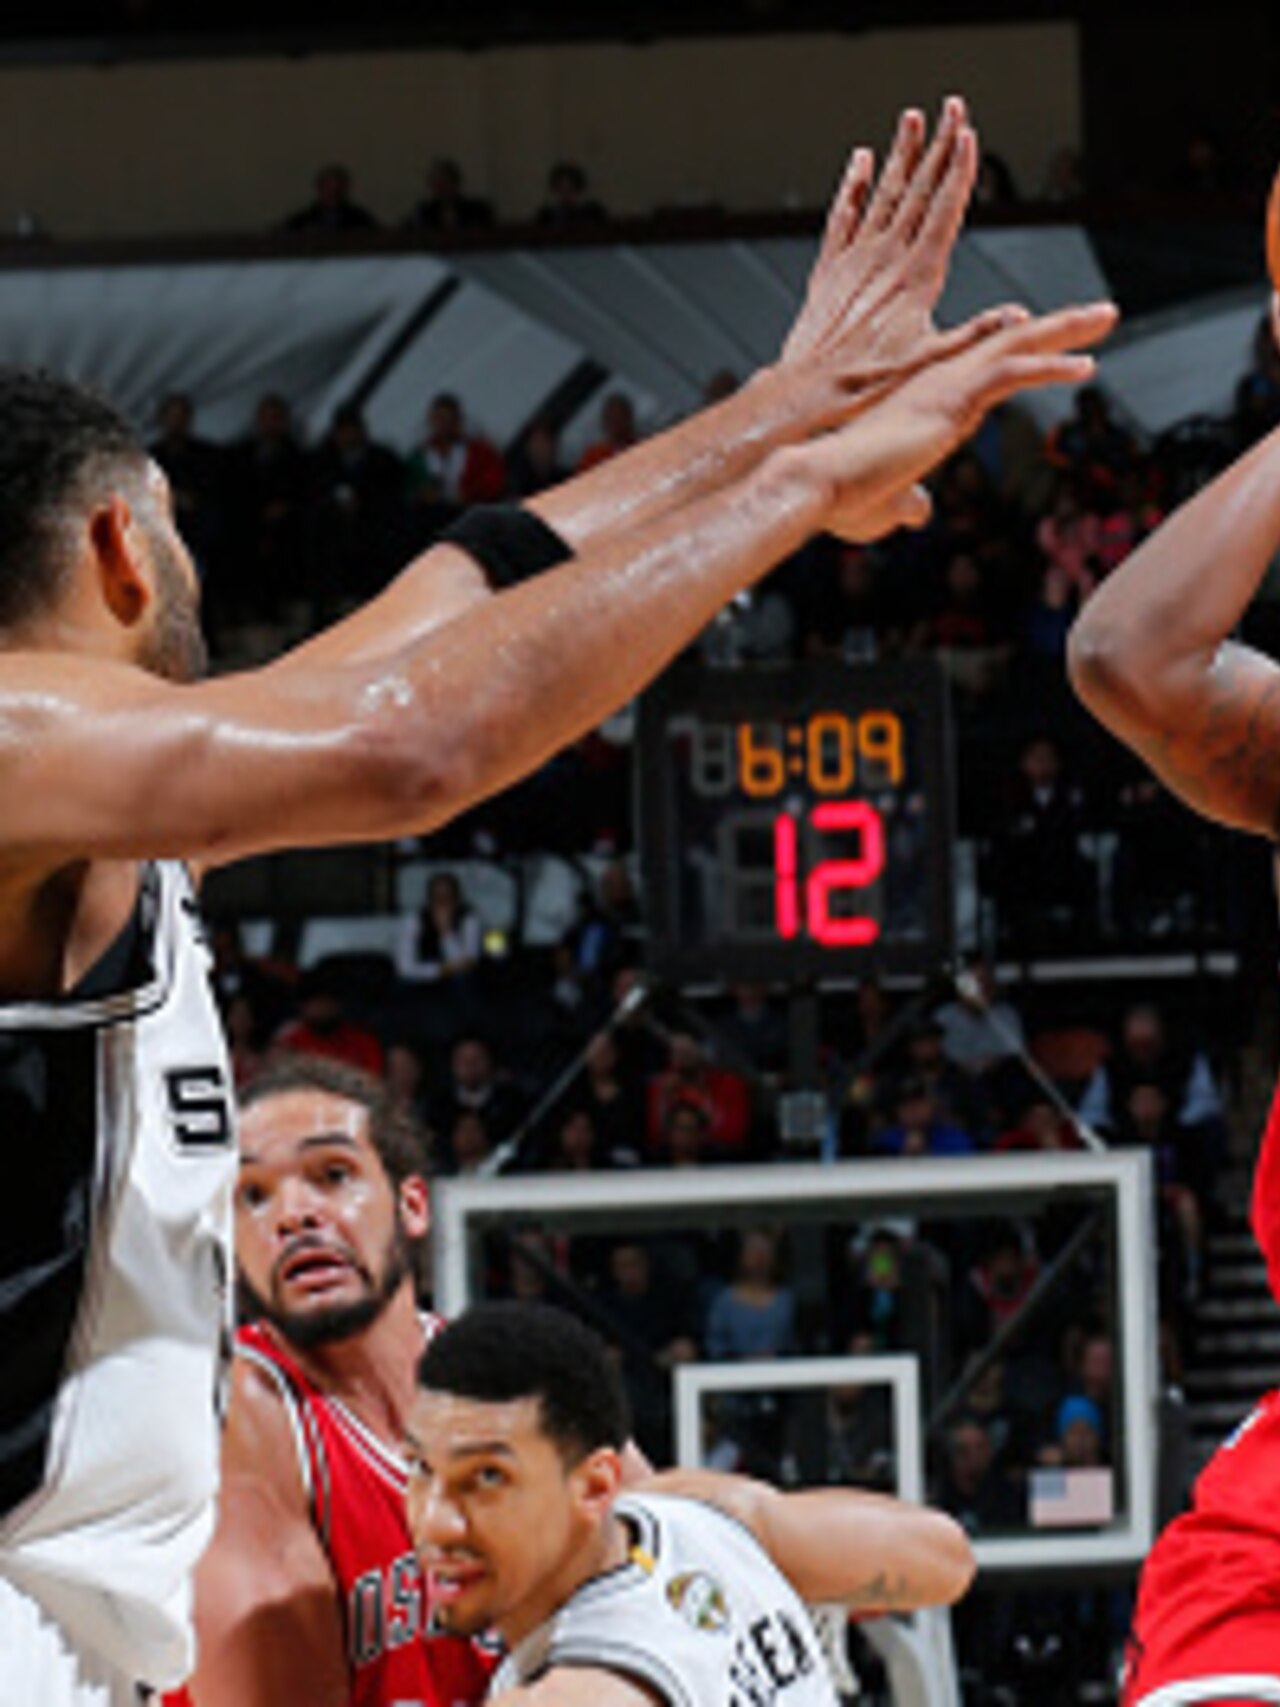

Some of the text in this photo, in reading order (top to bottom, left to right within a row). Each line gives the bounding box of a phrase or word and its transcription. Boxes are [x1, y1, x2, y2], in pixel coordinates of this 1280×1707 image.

[737, 709, 905, 797] 6:09
[774, 799, 886, 946] 12
[350, 1550, 422, 1669] OS
